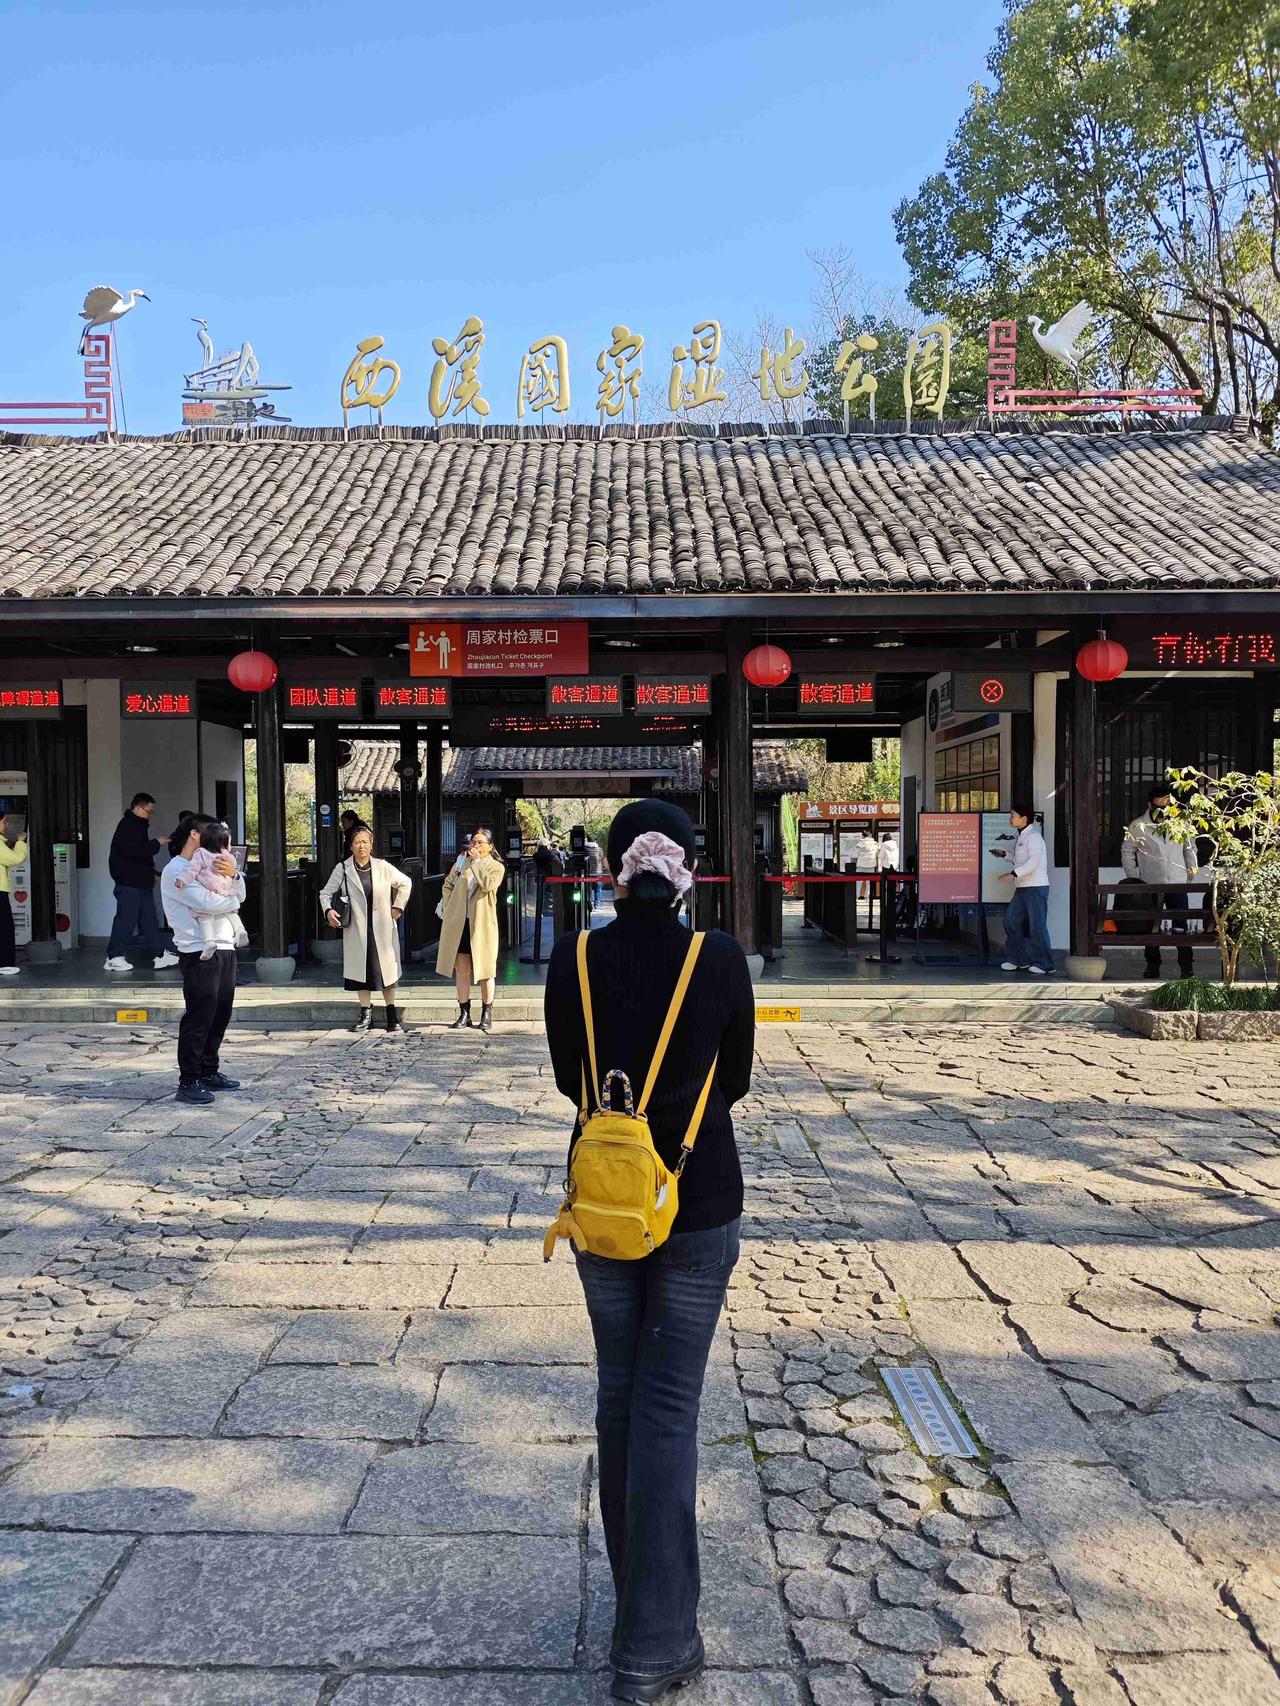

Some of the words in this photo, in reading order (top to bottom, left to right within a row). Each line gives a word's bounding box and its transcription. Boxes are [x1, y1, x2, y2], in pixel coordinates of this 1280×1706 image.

[466, 628, 558, 645] 周家村检票口
[467, 653, 500, 661] Zhoujiacun
[520, 653, 553, 661] Checkpoint
[0, 689, 59, 706] 障碍通道
[290, 687, 357, 706] 团队通道
[379, 687, 447, 705] 散客通道
[551, 684, 618, 704] 散客通道
[636, 683, 709, 705] 散客通道
[800, 682, 873, 704] 散客通道
[126, 694, 190, 713] 爱心通道
[828, 804, 878, 815] 景区导览图
